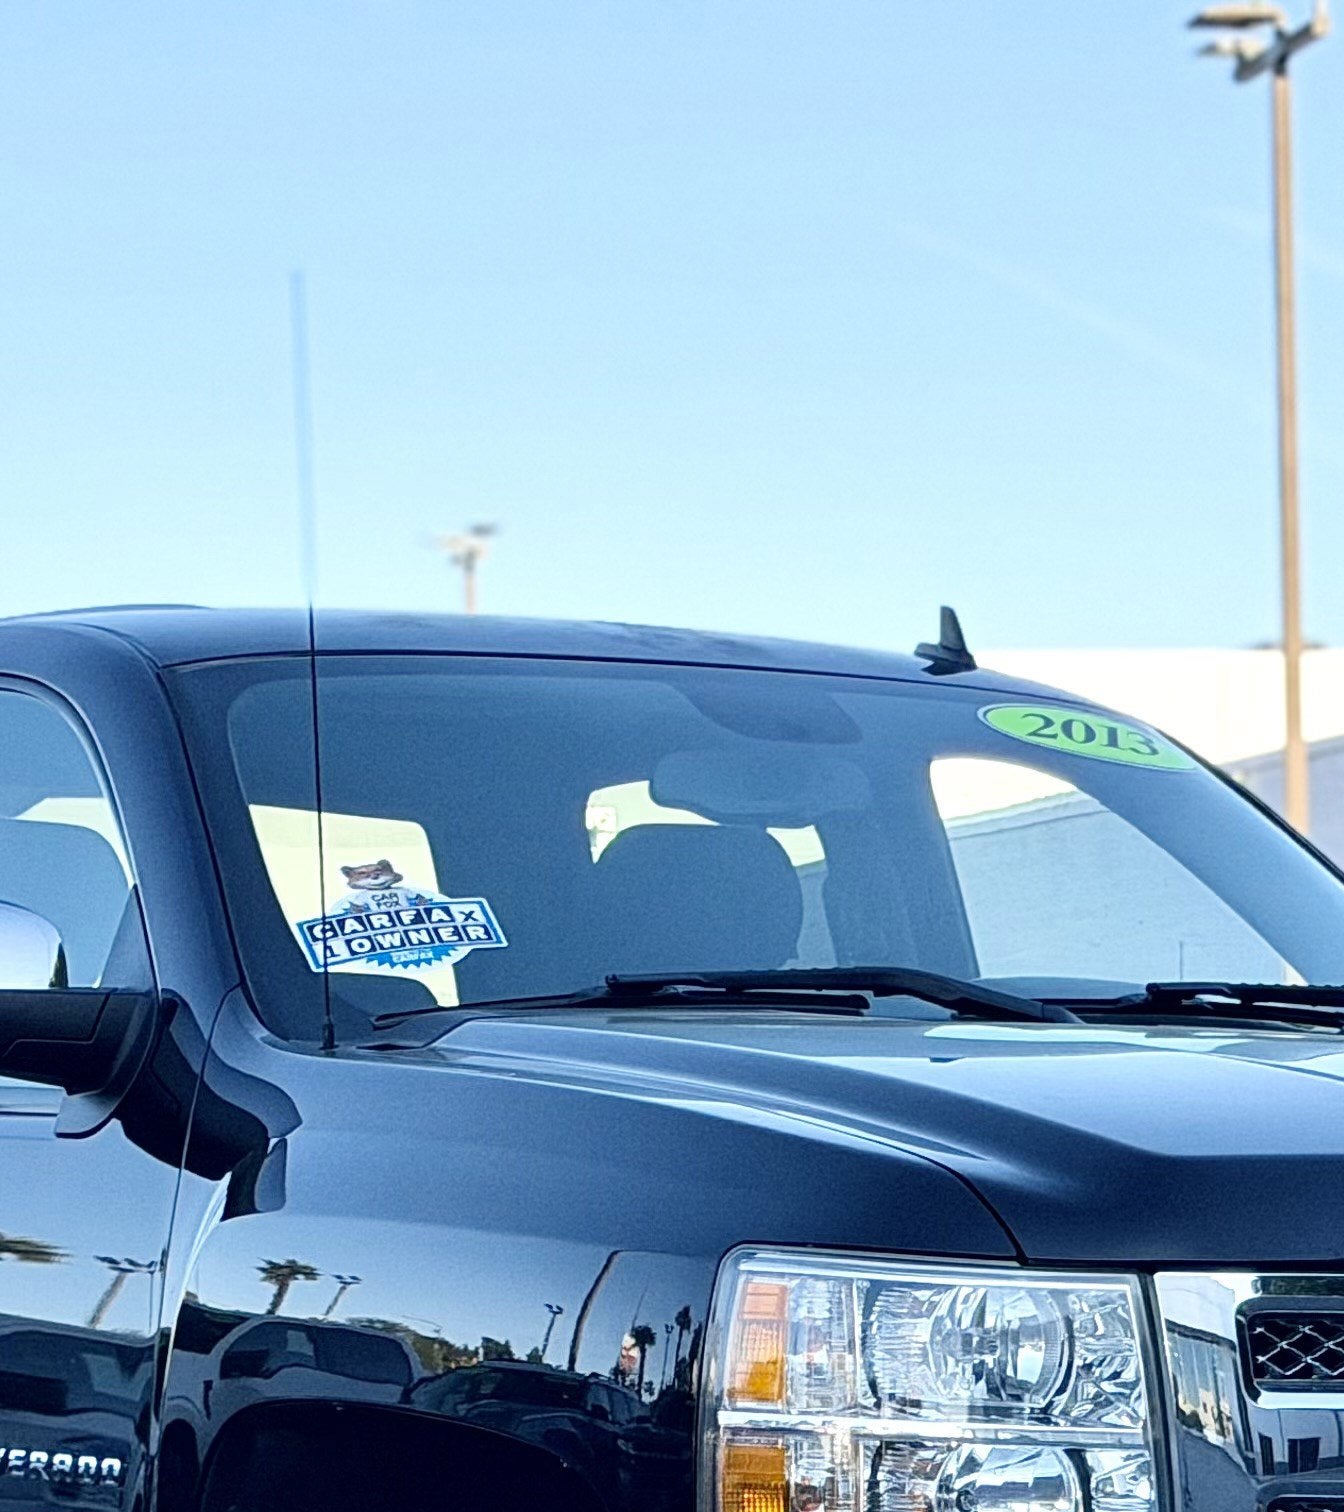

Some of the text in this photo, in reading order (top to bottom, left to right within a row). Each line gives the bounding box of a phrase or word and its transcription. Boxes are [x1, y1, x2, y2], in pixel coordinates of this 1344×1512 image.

[1022, 713, 1160, 757] 2013
[311, 908, 482, 940] CARFAX
[349, 926, 490, 954] OWNER
